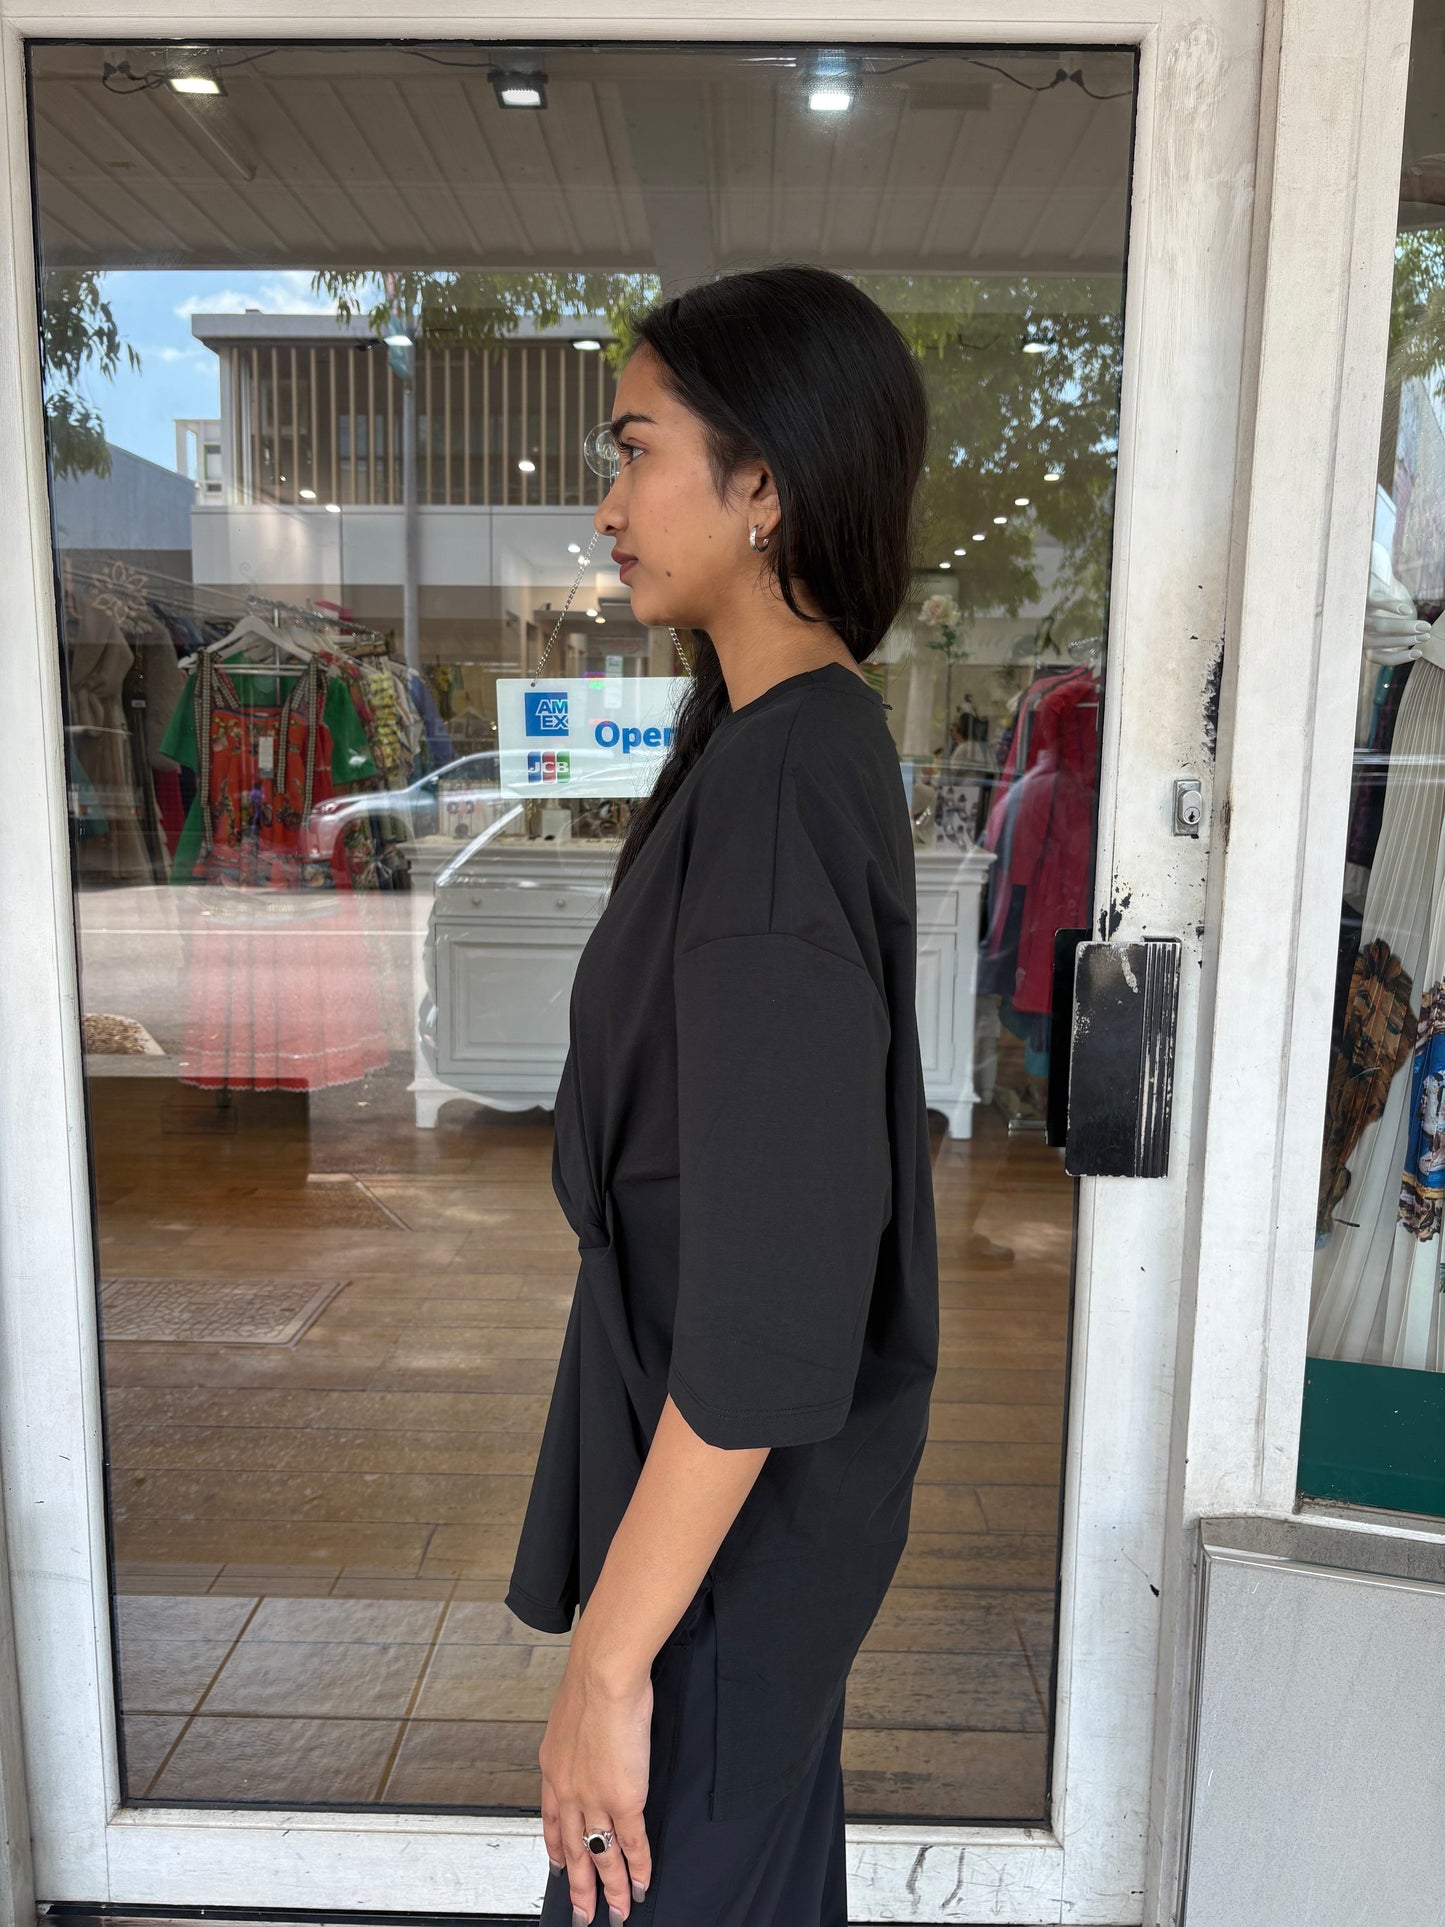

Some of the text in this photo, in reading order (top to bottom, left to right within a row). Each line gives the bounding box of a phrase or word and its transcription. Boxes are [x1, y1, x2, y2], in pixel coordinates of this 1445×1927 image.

[535, 699, 569, 715] AM
[540, 714, 569, 730] EX
[527, 761, 569, 774] JCB
